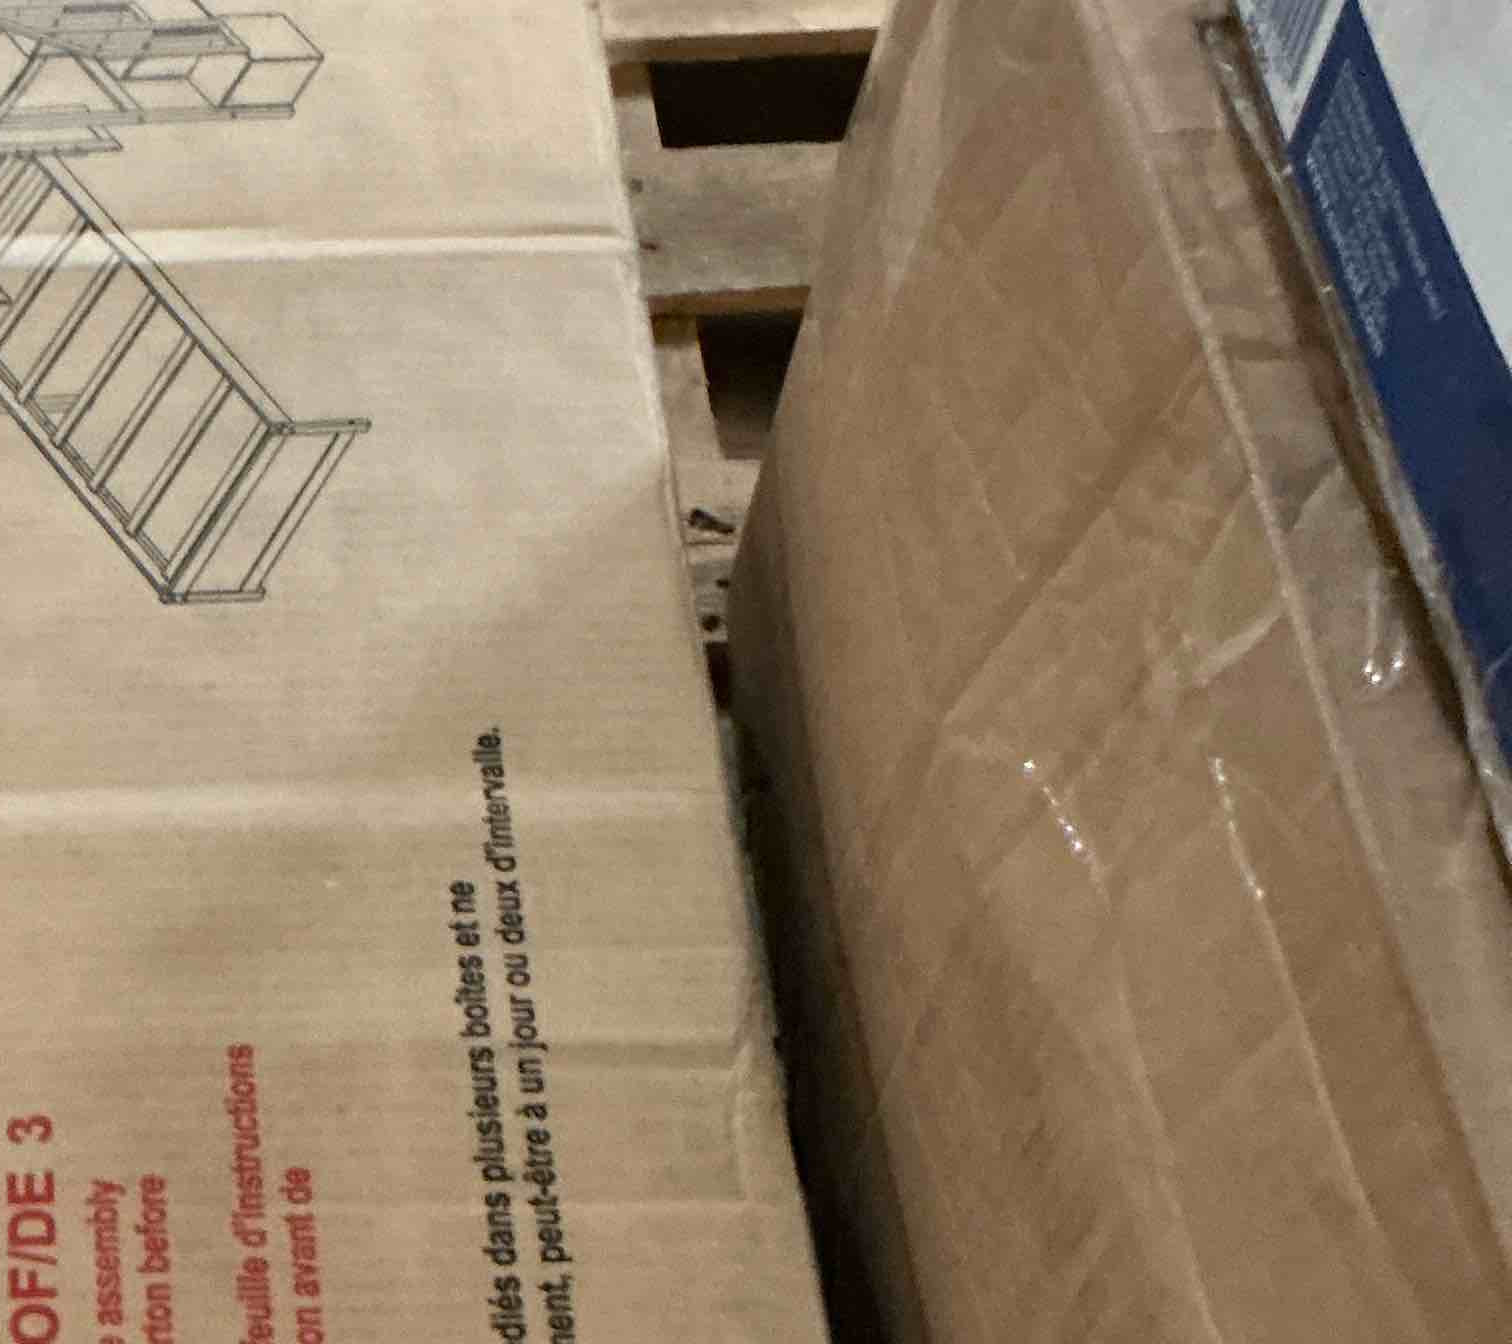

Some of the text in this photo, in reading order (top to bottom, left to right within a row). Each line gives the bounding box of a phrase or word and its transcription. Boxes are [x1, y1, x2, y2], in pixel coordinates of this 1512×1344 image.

[447, 881, 475, 913] ne
[490, 880, 525, 944] deux
[447, 922, 481, 947] et
[501, 954, 531, 986] ou
[506, 997, 548, 1051] jour
[516, 1059, 544, 1093] un
[6, 1114, 52, 1144] 3
[465, 1047, 513, 1182] plusieurs
[279, 1168, 313, 1204] de
[521, 1130, 572, 1263] peut-être
[86, 1180, 125, 1326] assembly
[135, 1175, 170, 1273] before
[481, 1192, 516, 1267] dans
[285, 1214, 320, 1297] avant
